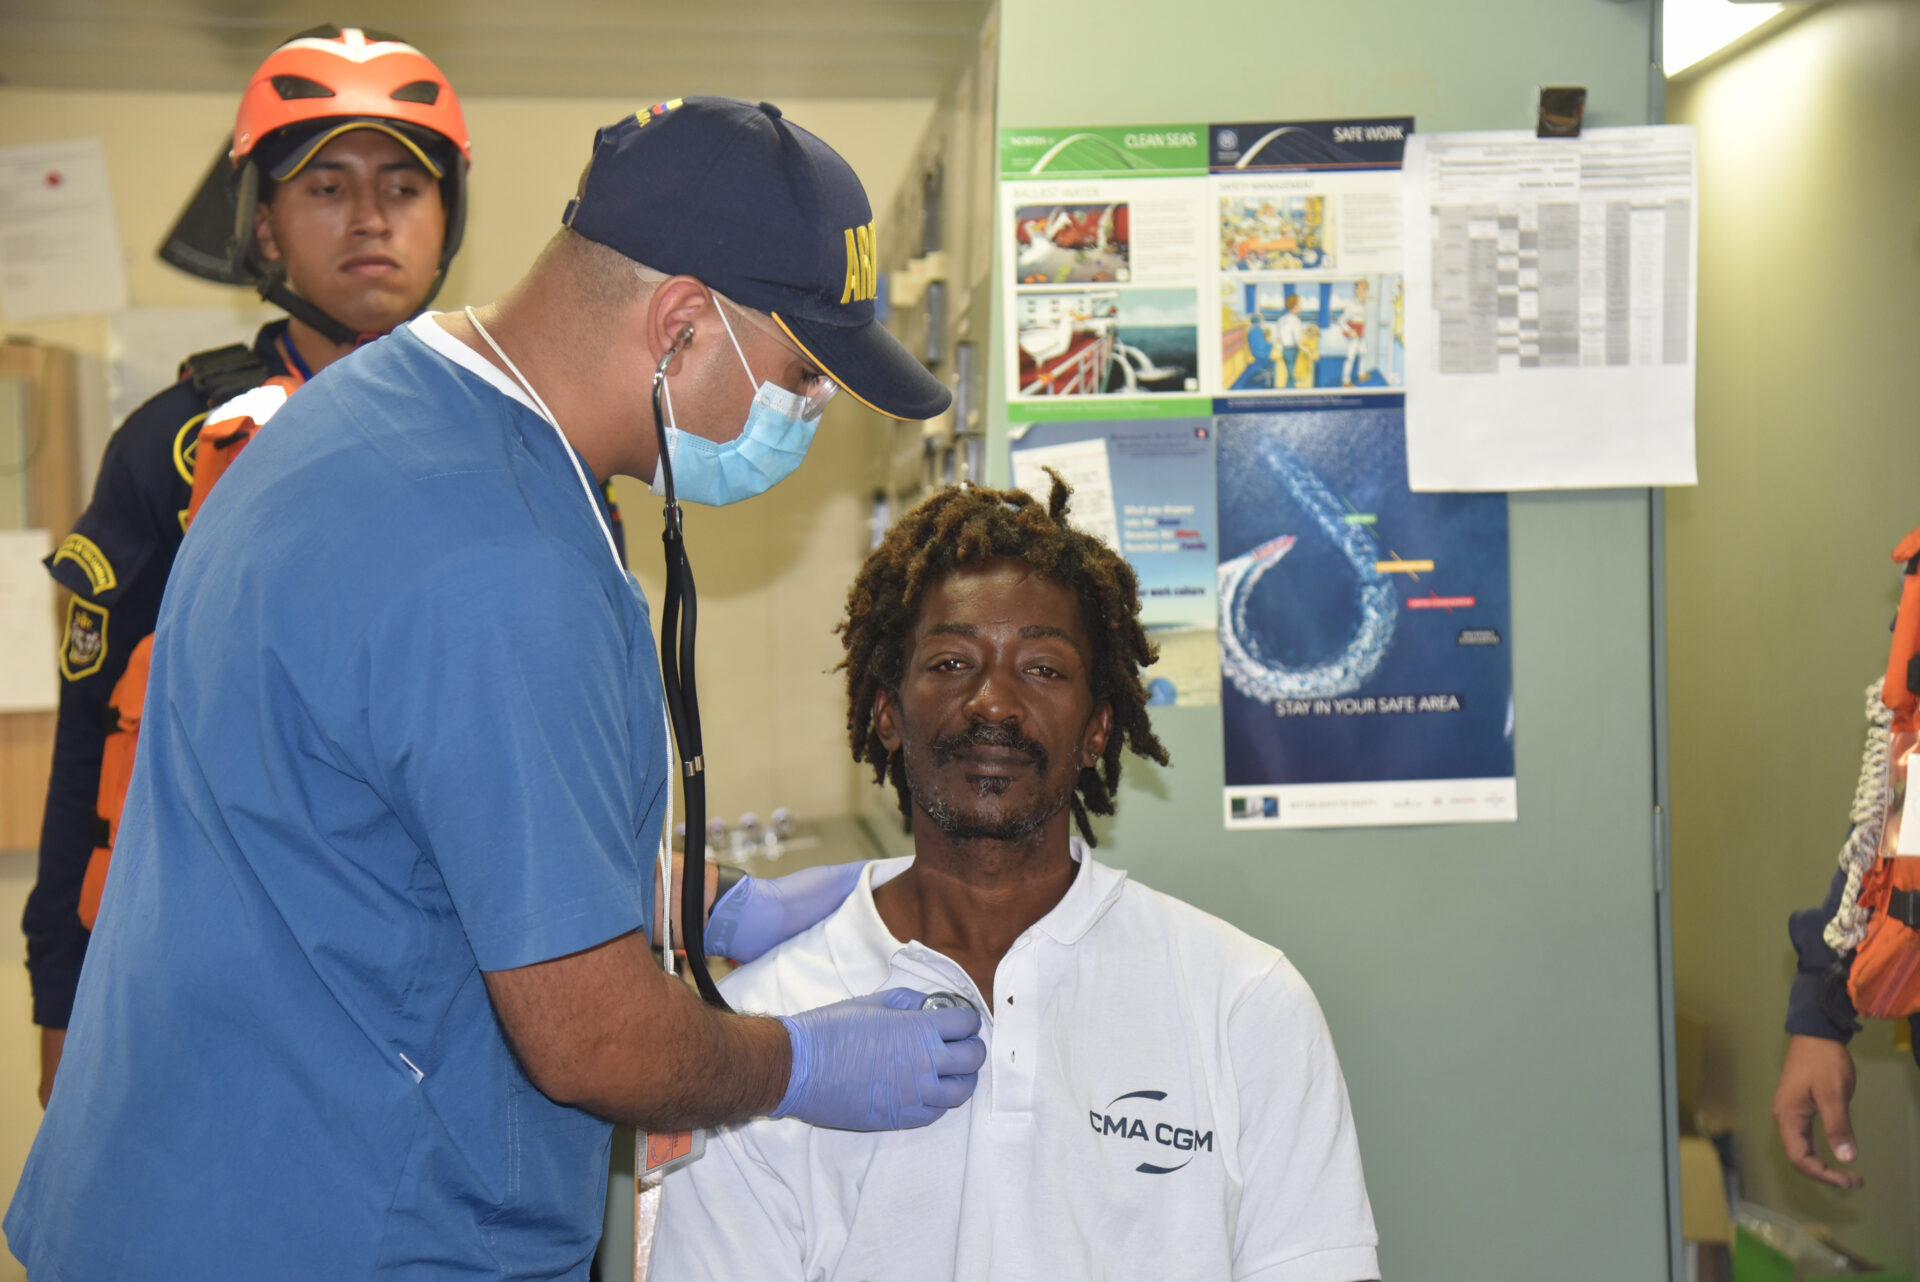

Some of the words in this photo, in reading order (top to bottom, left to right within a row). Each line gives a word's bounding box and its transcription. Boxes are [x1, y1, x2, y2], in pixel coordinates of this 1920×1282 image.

[1124, 133, 1163, 148] CLEAN
[1166, 132, 1198, 148] SEAS
[1333, 126, 1362, 143] SAFE
[1364, 125, 1404, 141] WORK
[1275, 700, 1312, 717] STAY
[1313, 699, 1331, 716] IN
[1333, 698, 1376, 715] YOUR
[1378, 696, 1416, 713] SAFE
[1417, 694, 1460, 713] AREA
[1089, 1109, 1150, 1142] CMA
[1155, 1122, 1213, 1153] CGM
